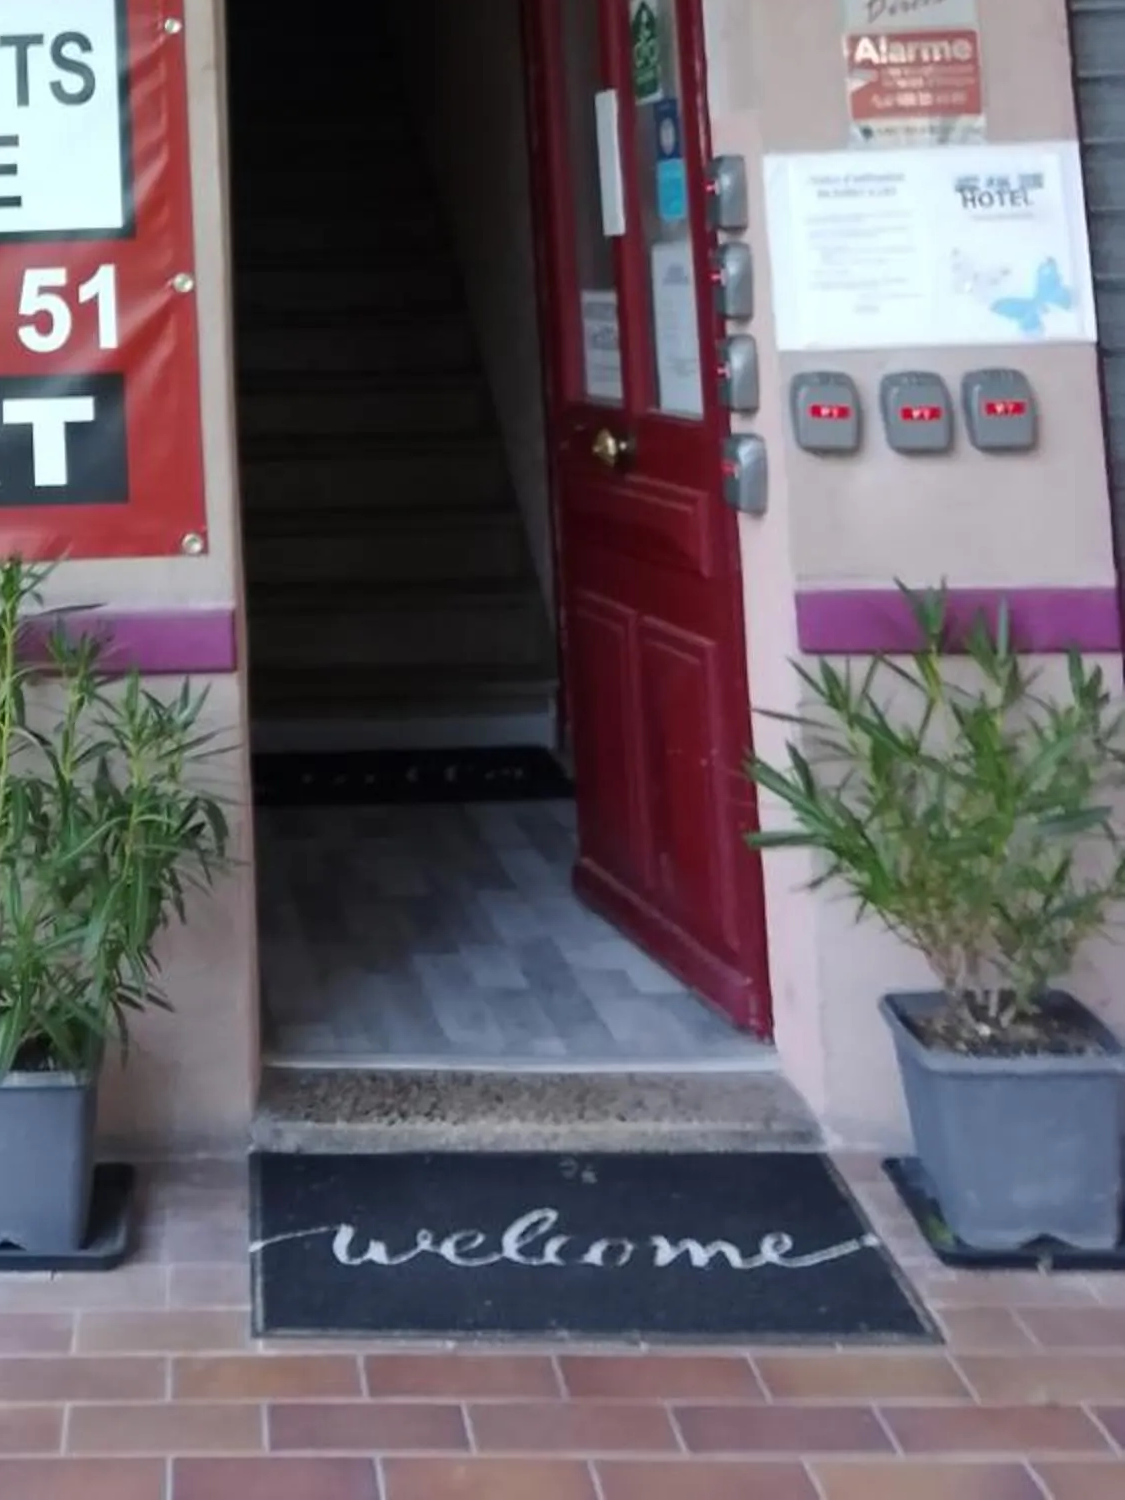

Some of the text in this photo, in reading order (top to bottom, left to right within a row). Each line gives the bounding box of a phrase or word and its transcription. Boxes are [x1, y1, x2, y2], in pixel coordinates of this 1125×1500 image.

[854, 35, 973, 64] Alarme
[18, 264, 118, 352] 51
[251, 1208, 878, 1269] welcome
